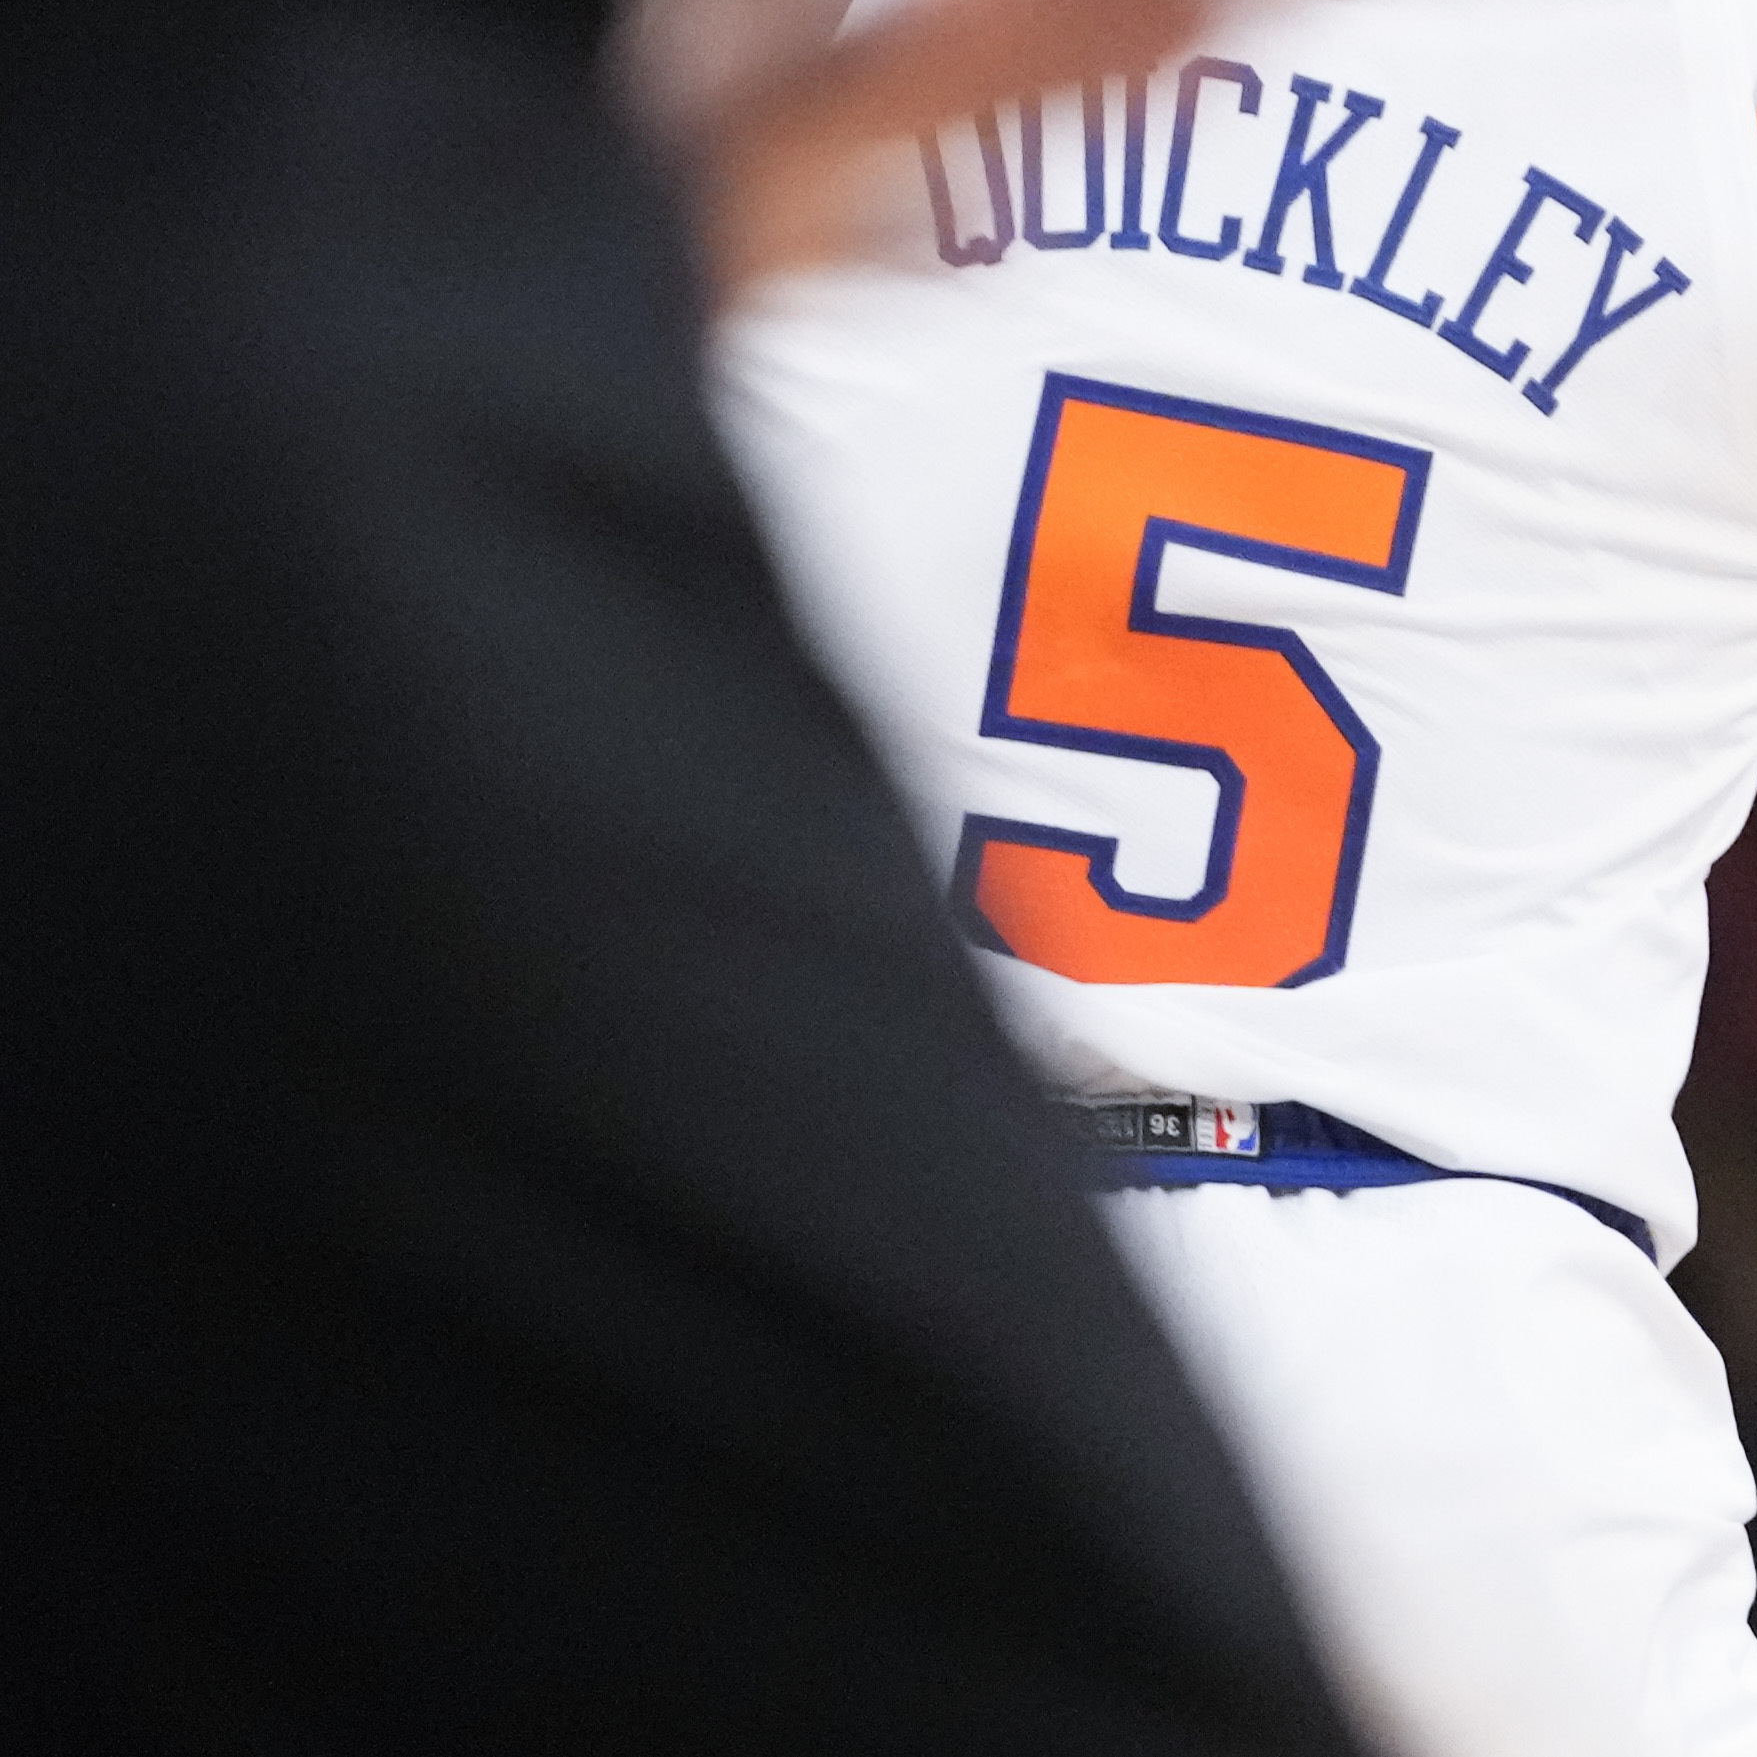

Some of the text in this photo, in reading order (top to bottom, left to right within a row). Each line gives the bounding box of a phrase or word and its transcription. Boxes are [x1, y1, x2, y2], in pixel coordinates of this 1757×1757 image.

[916, 55, 1692, 417] QUICKLEY
[950, 370, 1434, 989] 5
[1149, 1113, 1181, 1137] 36
